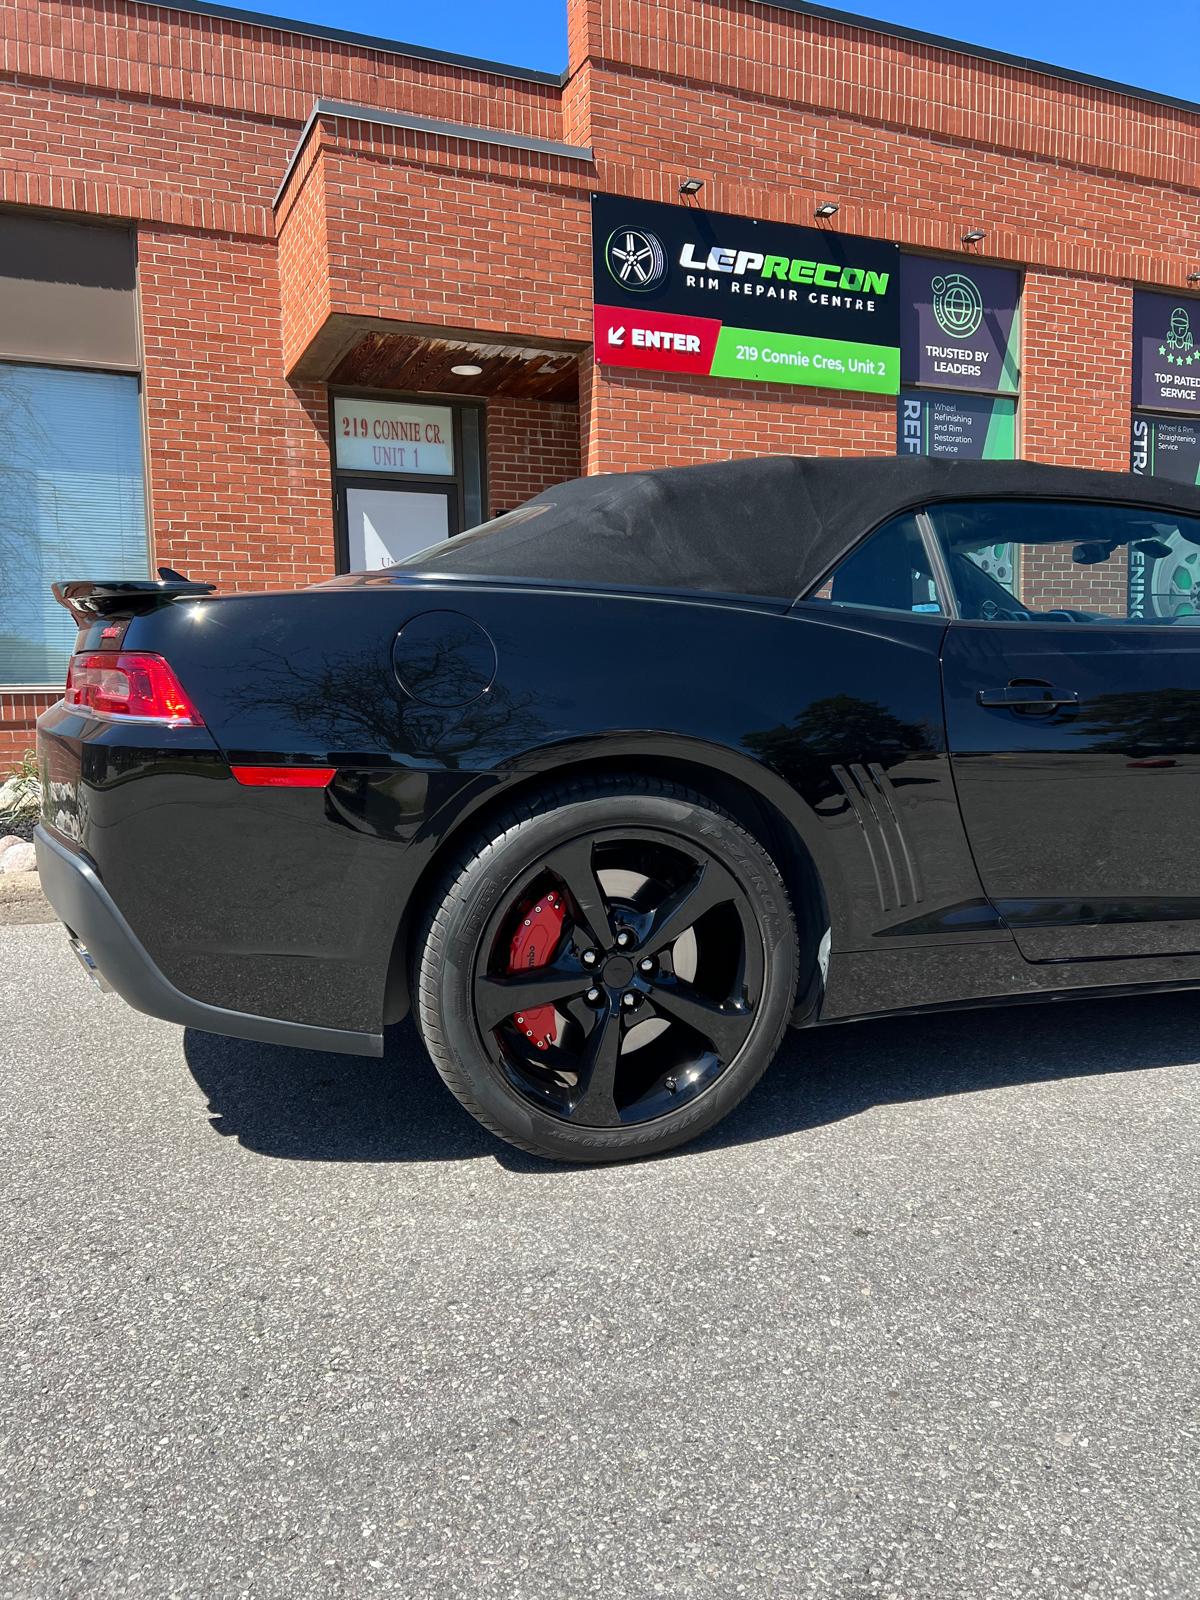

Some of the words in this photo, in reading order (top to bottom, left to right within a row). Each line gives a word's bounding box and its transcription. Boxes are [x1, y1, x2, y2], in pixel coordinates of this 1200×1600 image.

[679, 243, 890, 295] LEPRECON
[686, 275, 719, 290] RIM
[731, 283, 798, 301] REPAIR
[808, 292, 876, 312] CENTRE
[631, 328, 701, 353] ENTER
[735, 345, 758, 361] 219
[761, 349, 809, 367] Connie
[812, 355, 845, 373] Cres,
[848, 359, 874, 375] Unit
[877, 362, 886, 376] 2
[925, 345, 973, 360] TRUSTED
[974, 351, 989, 363] BY
[934, 362, 981, 376] LEADERS
[1154, 373, 1173, 384] TOP
[1174, 375, 1200, 387] RATED
[1160, 387, 1197, 400] SERVICE
[934, 403, 956, 412] Wheel
[934, 413, 972, 425] Refinishing
[342, 416, 369, 438] 219
[373, 419, 421, 443] CONNIE
[425, 424, 445, 444] CR.
[904, 400, 920, 454] REF
[934, 424, 947, 432] and
[948, 425, 962, 433] Rim
[1159, 424, 1177, 432] Wheel
[1177, 425, 1182, 433] &
[934, 433, 972, 443] Restoration
[1158, 433, 1196, 444] Straightening
[934, 443, 958, 453] Service
[1158, 443, 1178, 451] Service
[372, 445, 405, 467] UNIT
[413, 447, 419, 468] 1
